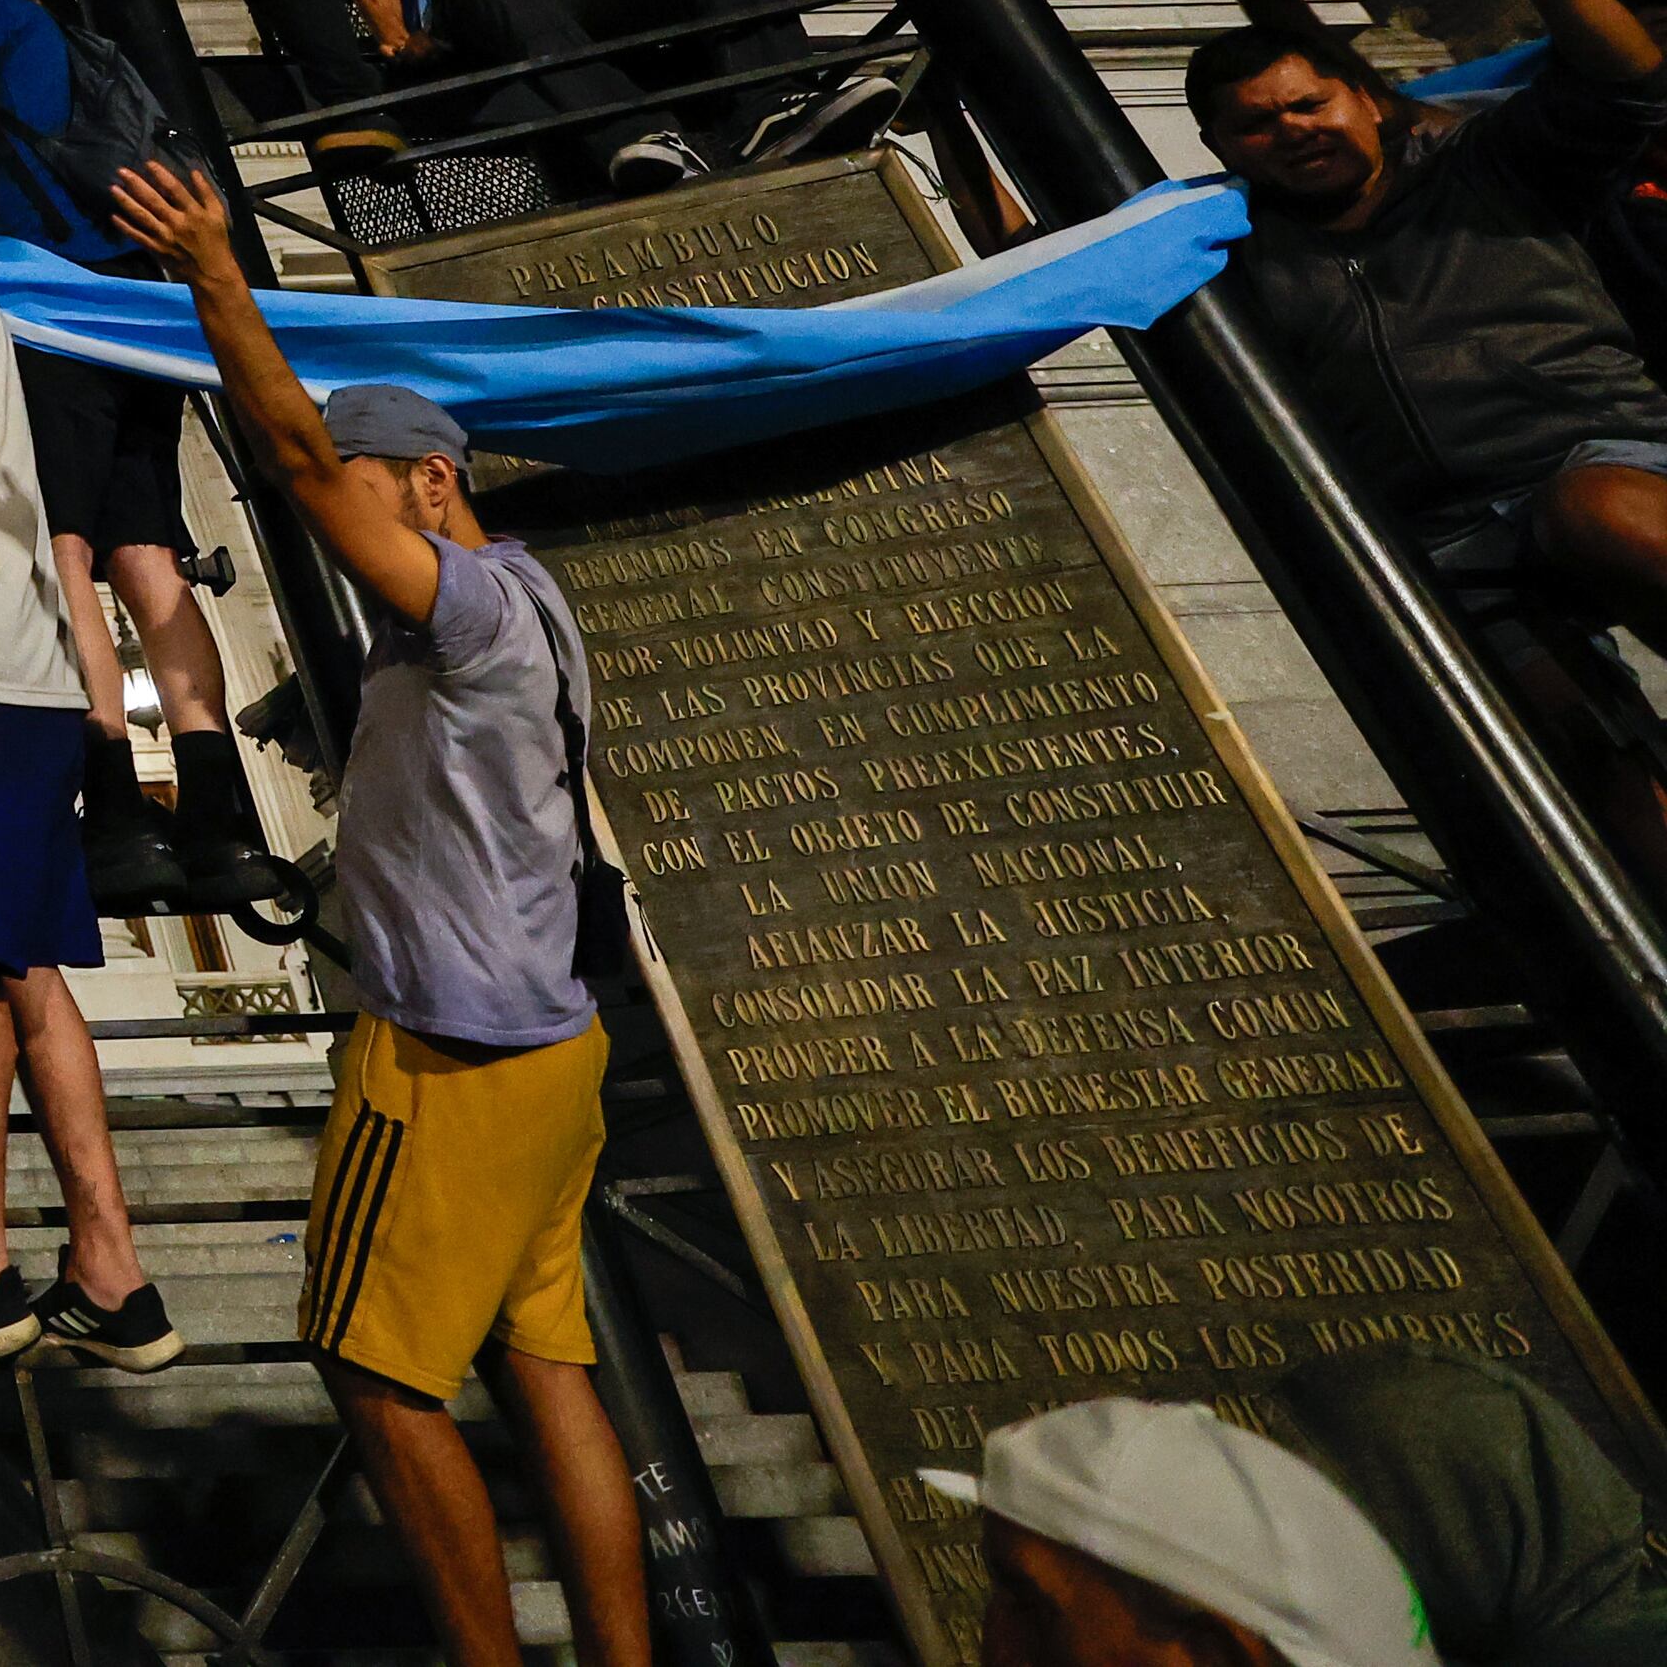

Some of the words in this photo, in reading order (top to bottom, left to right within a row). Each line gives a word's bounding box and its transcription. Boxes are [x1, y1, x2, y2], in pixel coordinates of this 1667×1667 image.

[508, 213, 781, 297] PREAMBULO
[563, 537, 733, 592] REUNIDOS
[753, 525, 804, 560] EN
[822, 489, 1015, 548] CONGRESO
[574, 584, 734, 634] GENERAL
[669, 617, 838, 670] VOLUNTAD
[854, 609, 881, 642] Y
[902, 580, 1073, 635] ELECCION
[597, 696, 643, 731] DE
[658, 684, 727, 723] LAS
[741, 648, 955, 708] PROVINCIAS
[973, 635, 1049, 677] QUE
[1062, 625, 1121, 662] LA
[605, 724, 802, 779] COMPONEN,
[816, 713, 867, 749] EN
[884, 671, 1160, 738] CUMPLIMIENTO
[642, 788, 692, 825] DE
[714, 766, 841, 814] PACTOS
[642, 836, 707, 877] CON
[723, 829, 772, 865] EL
[789, 809, 923, 857] OBJETO
[938, 799, 990, 835] DE
[1005, 770, 1228, 828] CONSTITUIR
[739, 878, 794, 917] LA
[819, 860, 939, 905] UNION
[747, 917, 932, 971] AFIANZAR
[950, 909, 1008, 948] LA
[1033, 884, 1231, 939] JUSTICIA,
[712, 972, 938, 1028] CONSOLIDAR
[951, 966, 1011, 1005] LA
[1024, 955, 1105, 998] PAZ
[1118, 933, 1316, 989] INTERIOR
[726, 1035, 897, 1086] PROVEER
[910, 1030, 939, 1069] A
[946, 1024, 1004, 1063] LA
[1012, 1006, 1196, 1059] DEFENSA
[1206, 989, 1353, 1040] COMUN
[736, 1088, 933, 1142] PROMOVER
[934, 1084, 991, 1125] EL
[994, 1063, 1212, 1119] BIENESTAR
[1216, 1048, 1402, 1101] GENERAL
[770, 1160, 802, 1202] Y
[814, 1146, 1007, 1200] ASEGURAR
[1013, 1139, 1092, 1184] LOS
[1101, 1117, 1348, 1177] BENEFICIOS
[1357, 1112, 1427, 1158] DE
[804, 1221, 863, 1262] LA
[871, 1204, 1085, 1259] LIBERTAD,
[1106, 1193, 1227, 1240] PARA
[1232, 1177, 1454, 1232] NOSOTROS
[856, 1277, 971, 1322] PARA
[989, 1260, 1180, 1314] NUESTRA
[1197, 1245, 1464, 1302] POSTERIDAD
[859, 1342, 893, 1386] Y
[910, 1336, 1022, 1384] PARA
[1037, 1329, 1179, 1377] TODOS
[1198, 1321, 1286, 1371] LOS
[633, 1461, 674, 1502] TE
